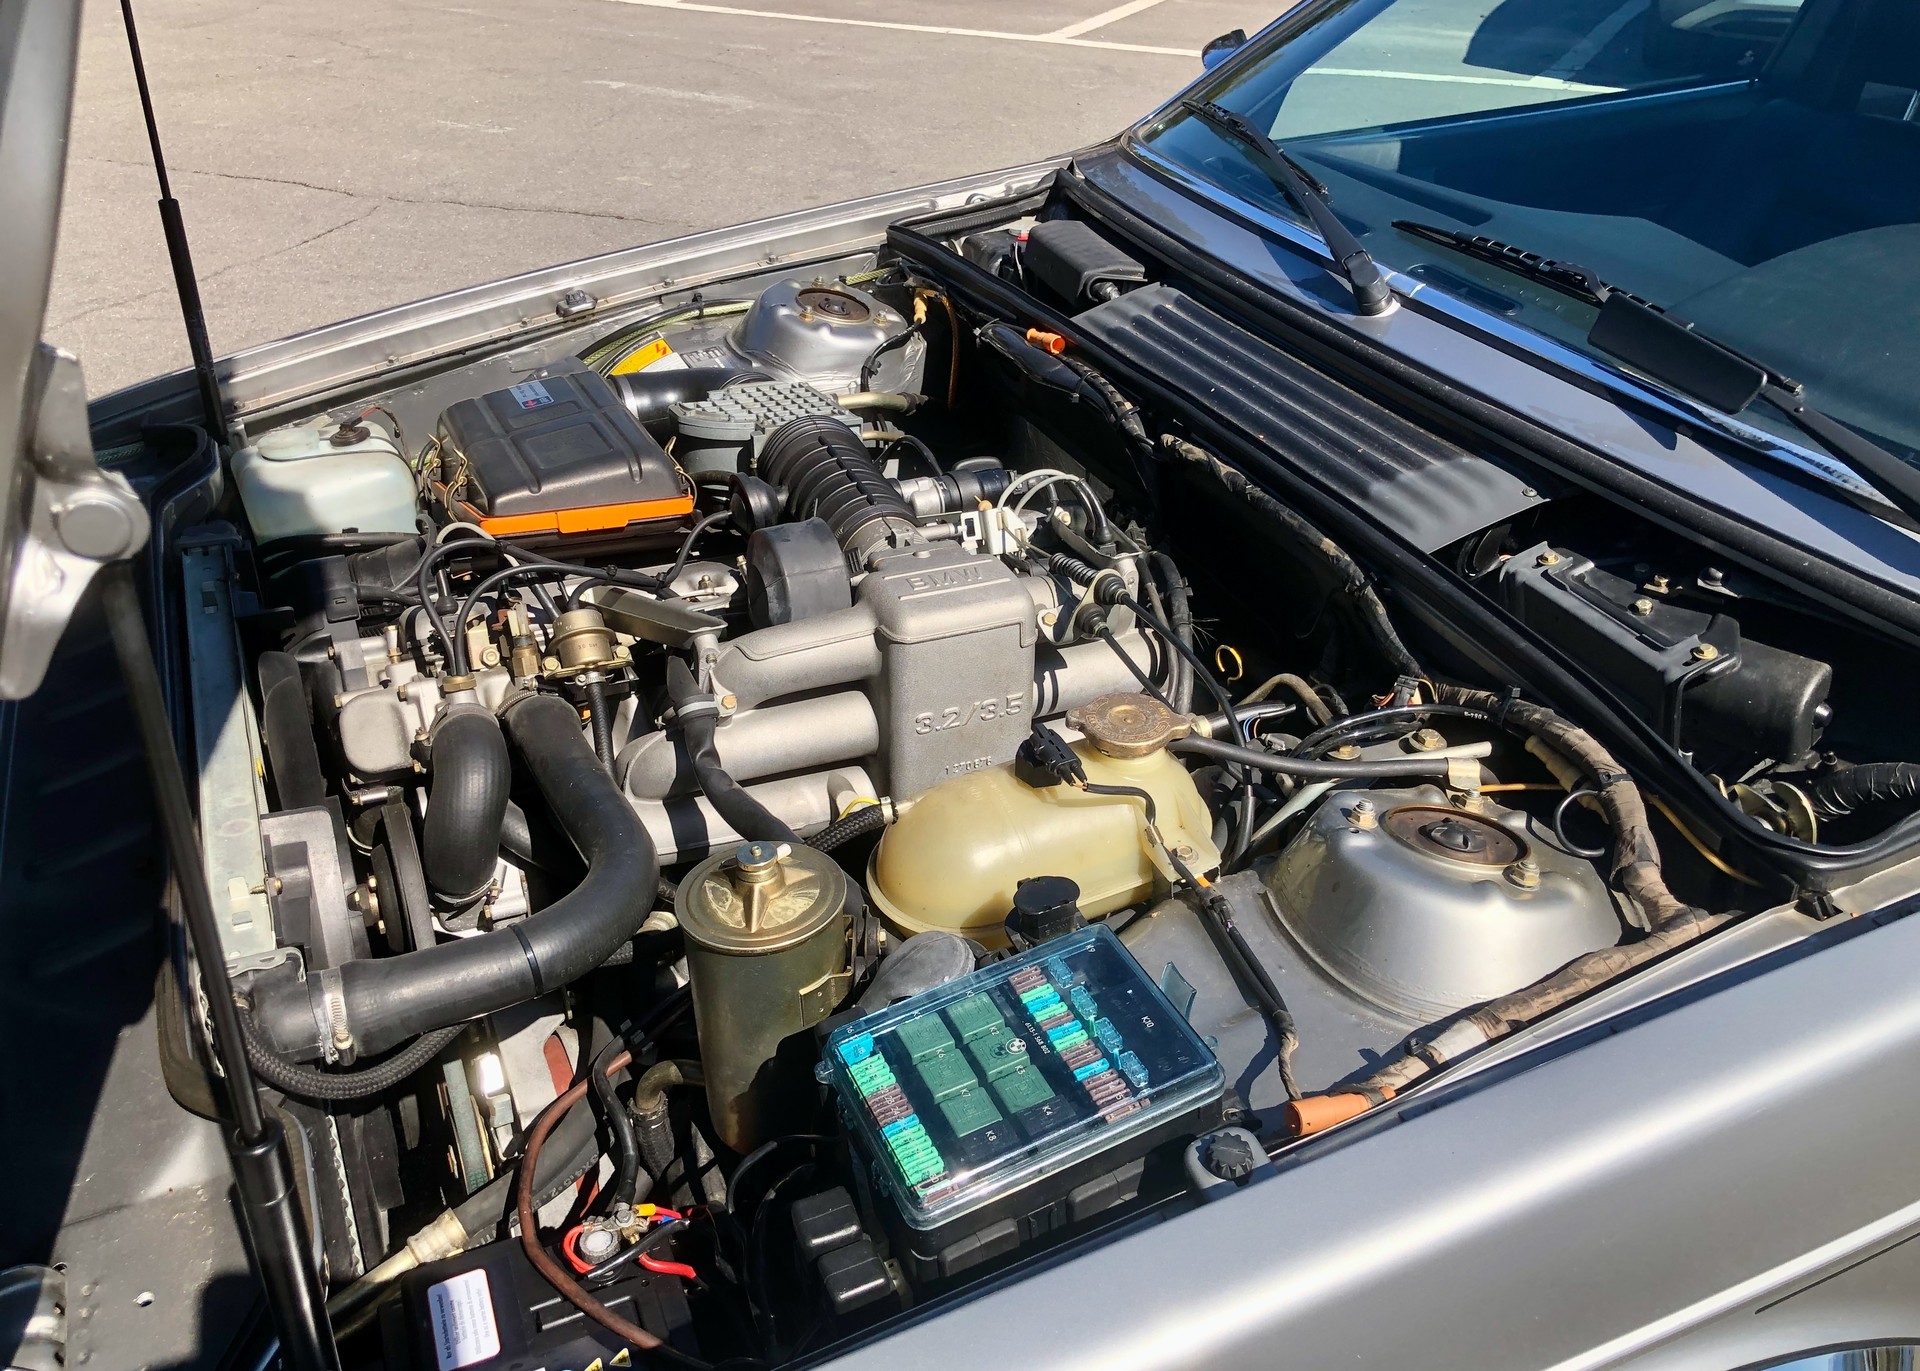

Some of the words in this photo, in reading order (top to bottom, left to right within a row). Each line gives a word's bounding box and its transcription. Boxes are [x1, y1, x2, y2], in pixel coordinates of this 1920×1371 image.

[905, 566, 984, 591] BMW
[915, 692, 1025, 736] 3.2/3.5
[1141, 1015, 1155, 1028] K10
[989, 1026, 999, 1036] K2
[936, 1048, 946, 1059] K6
[1015, 1064, 1026, 1075] K3
[960, 1087, 971, 1097] K7
[1042, 1102, 1054, 1115] K4
[985, 1129, 997, 1142] K8
